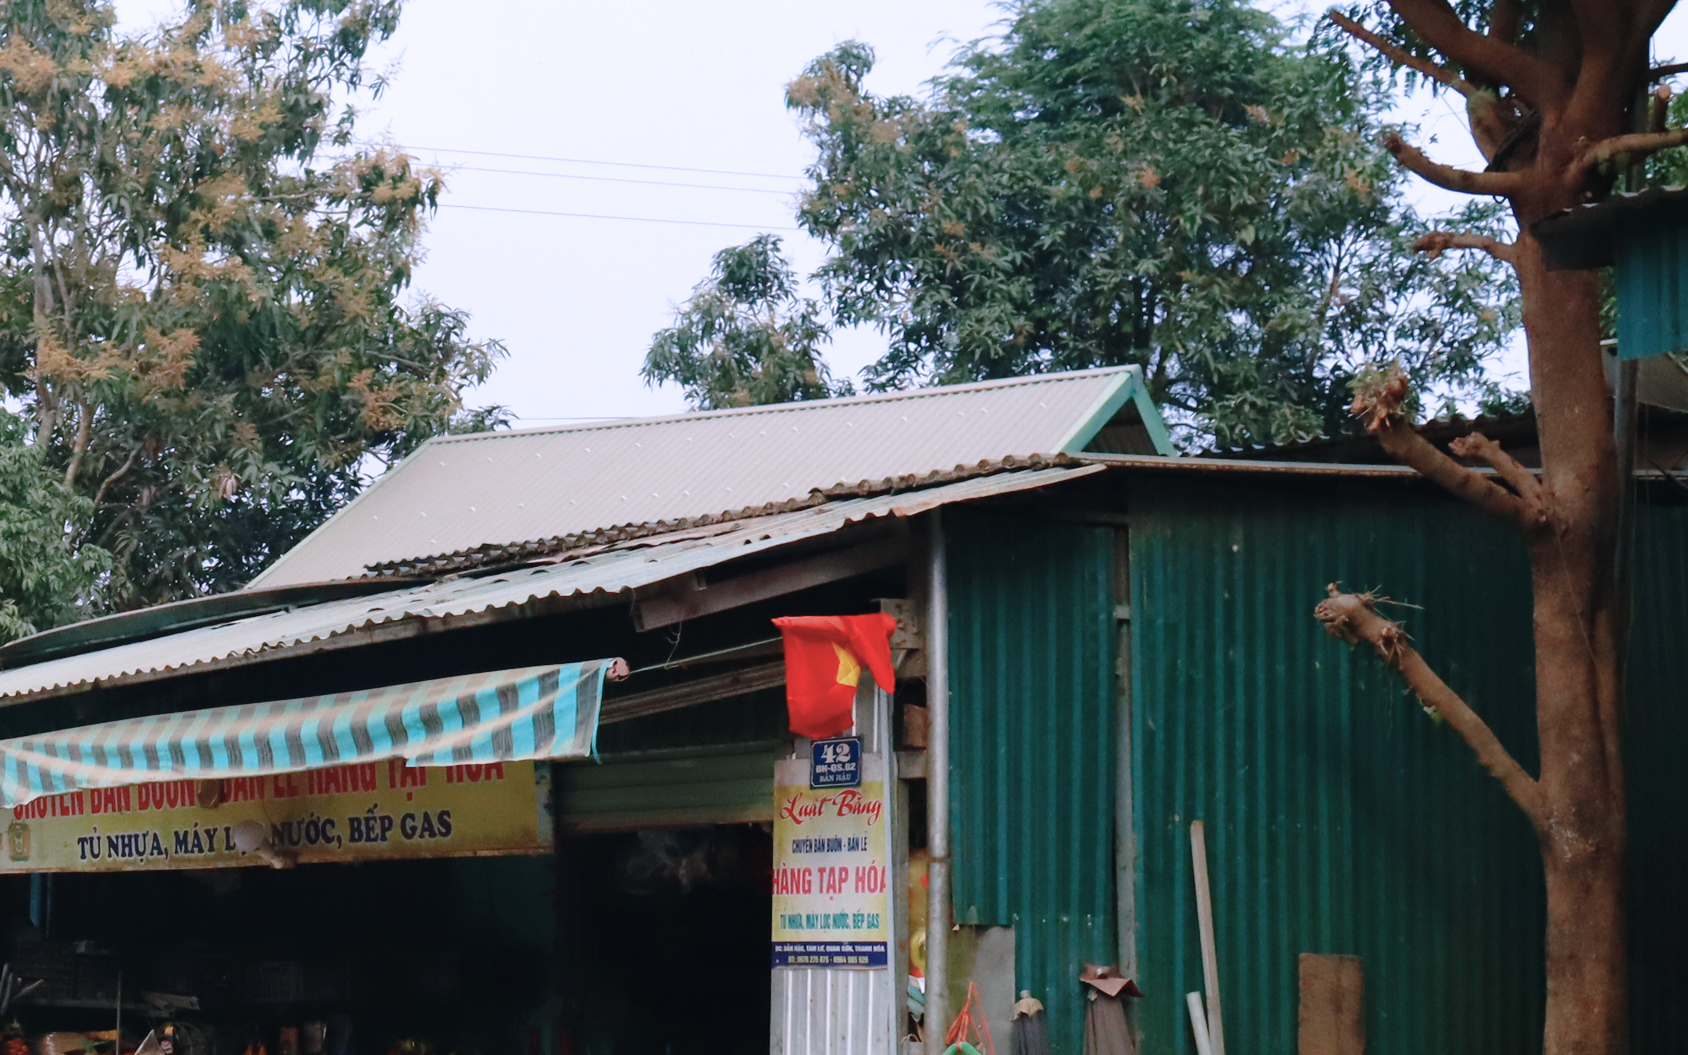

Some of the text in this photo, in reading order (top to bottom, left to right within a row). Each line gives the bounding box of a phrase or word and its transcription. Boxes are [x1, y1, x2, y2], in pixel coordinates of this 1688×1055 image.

[821, 743, 851, 763] 42
[77, 826, 101, 860] TỦ
[174, 821, 218, 855] MÁY
[348, 803, 393, 843] BẾP
[400, 810, 453, 840] GAS
[772, 861, 812, 895] HÀNG
[818, 866, 849, 901] TẠP
[867, 913, 880, 929] GAS
